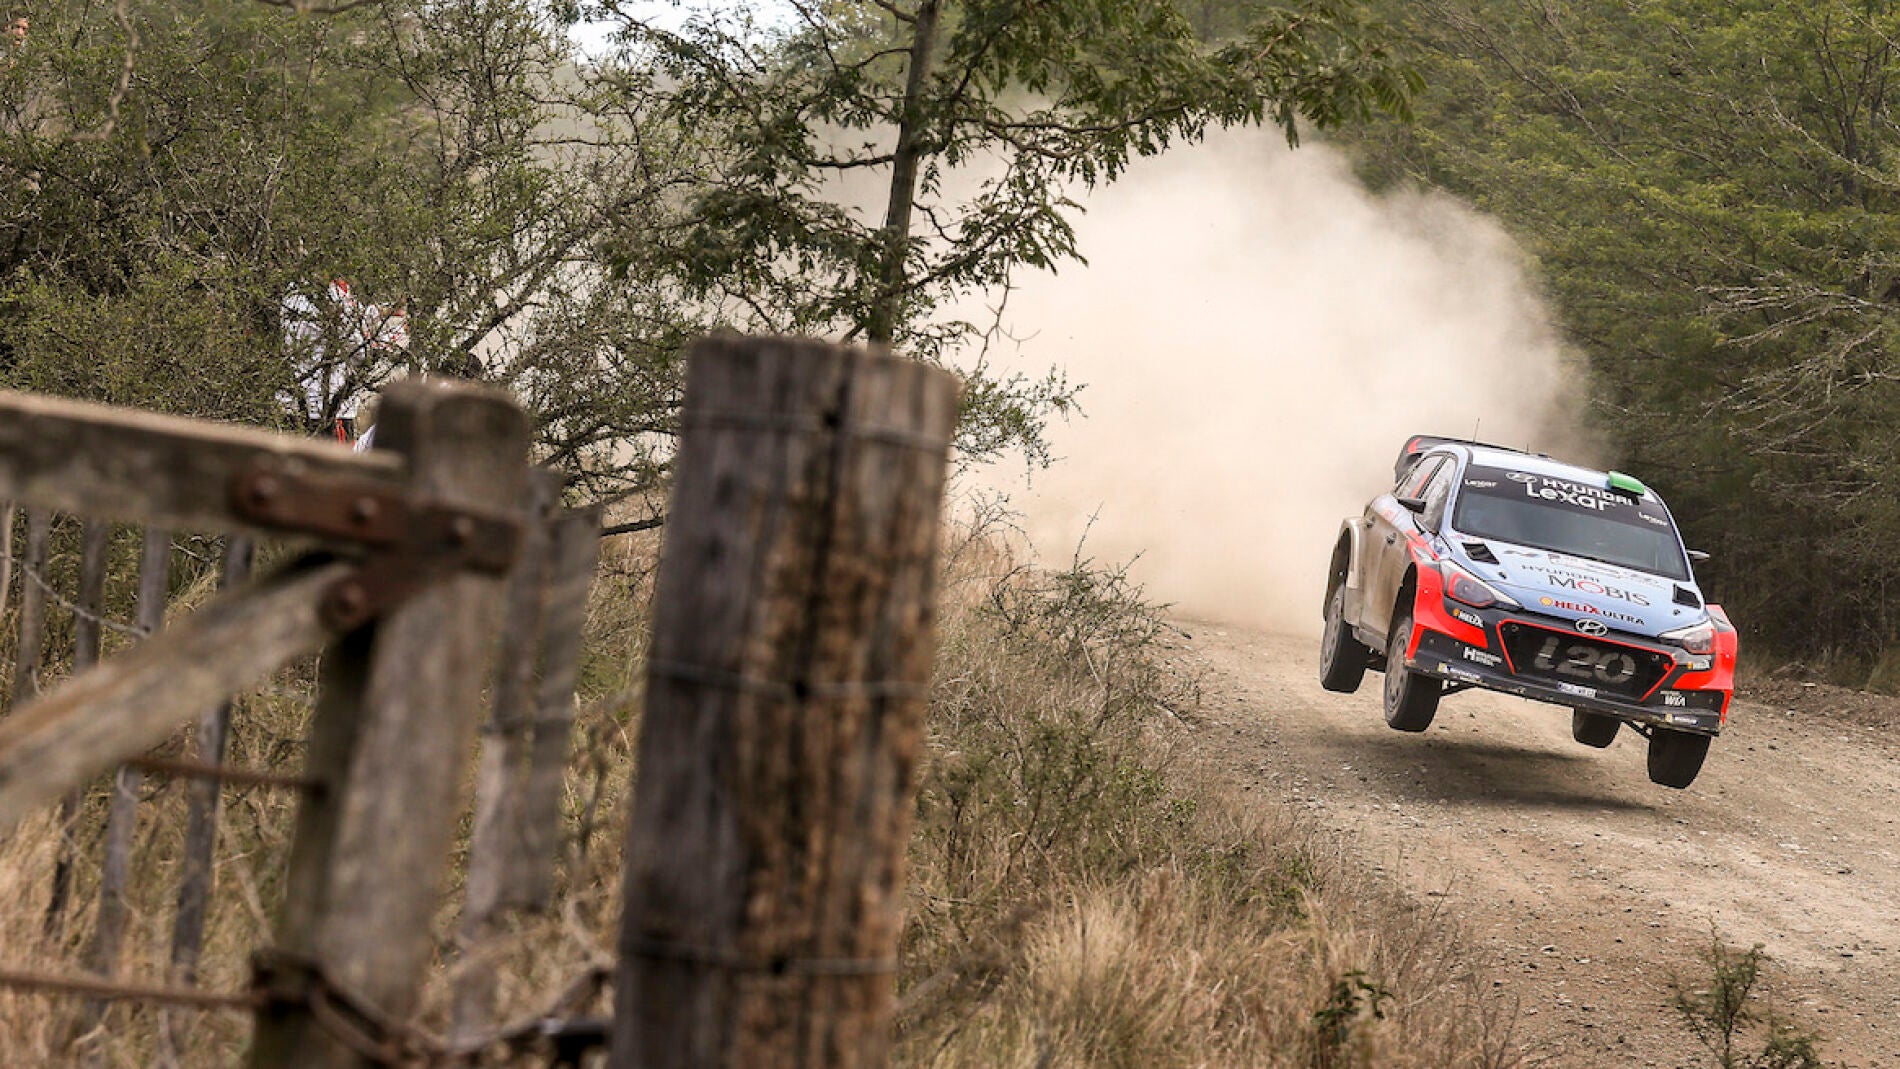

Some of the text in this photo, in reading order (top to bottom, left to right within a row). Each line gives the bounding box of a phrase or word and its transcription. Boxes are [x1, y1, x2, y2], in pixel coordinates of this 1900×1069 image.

[1526, 482, 1616, 511] Lexar
[1542, 478, 1632, 506] HYUNDAI
[1549, 575, 1650, 607] MOBIS
[1555, 601, 1645, 626] HELIX ULTRA
